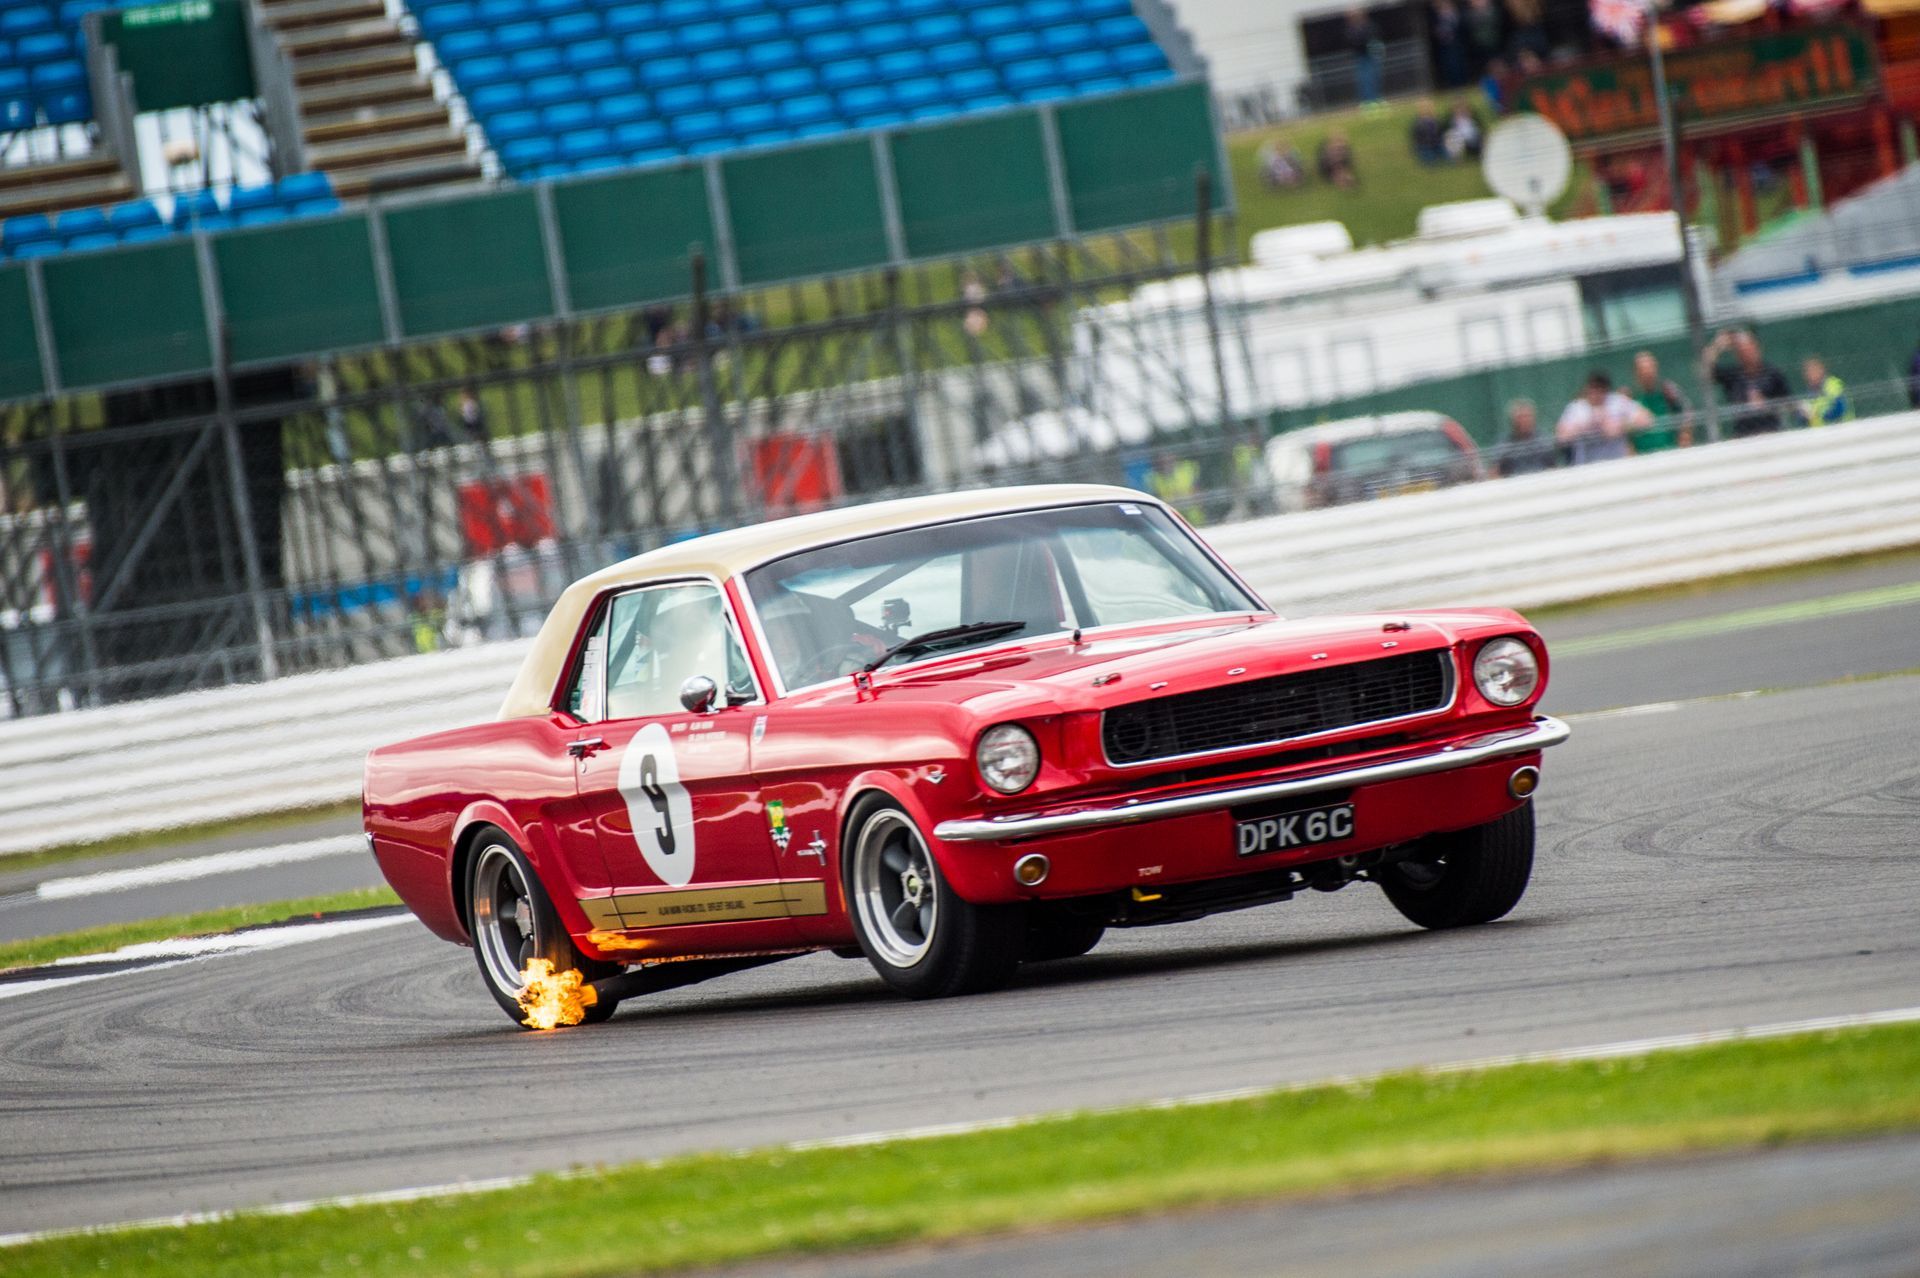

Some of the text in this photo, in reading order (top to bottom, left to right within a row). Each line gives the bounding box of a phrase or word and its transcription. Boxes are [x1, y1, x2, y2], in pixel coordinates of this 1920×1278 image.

[640, 754, 675, 855] 9
[1240, 807, 1353, 855] DPK 6C
[1138, 865, 1163, 876] TOW
